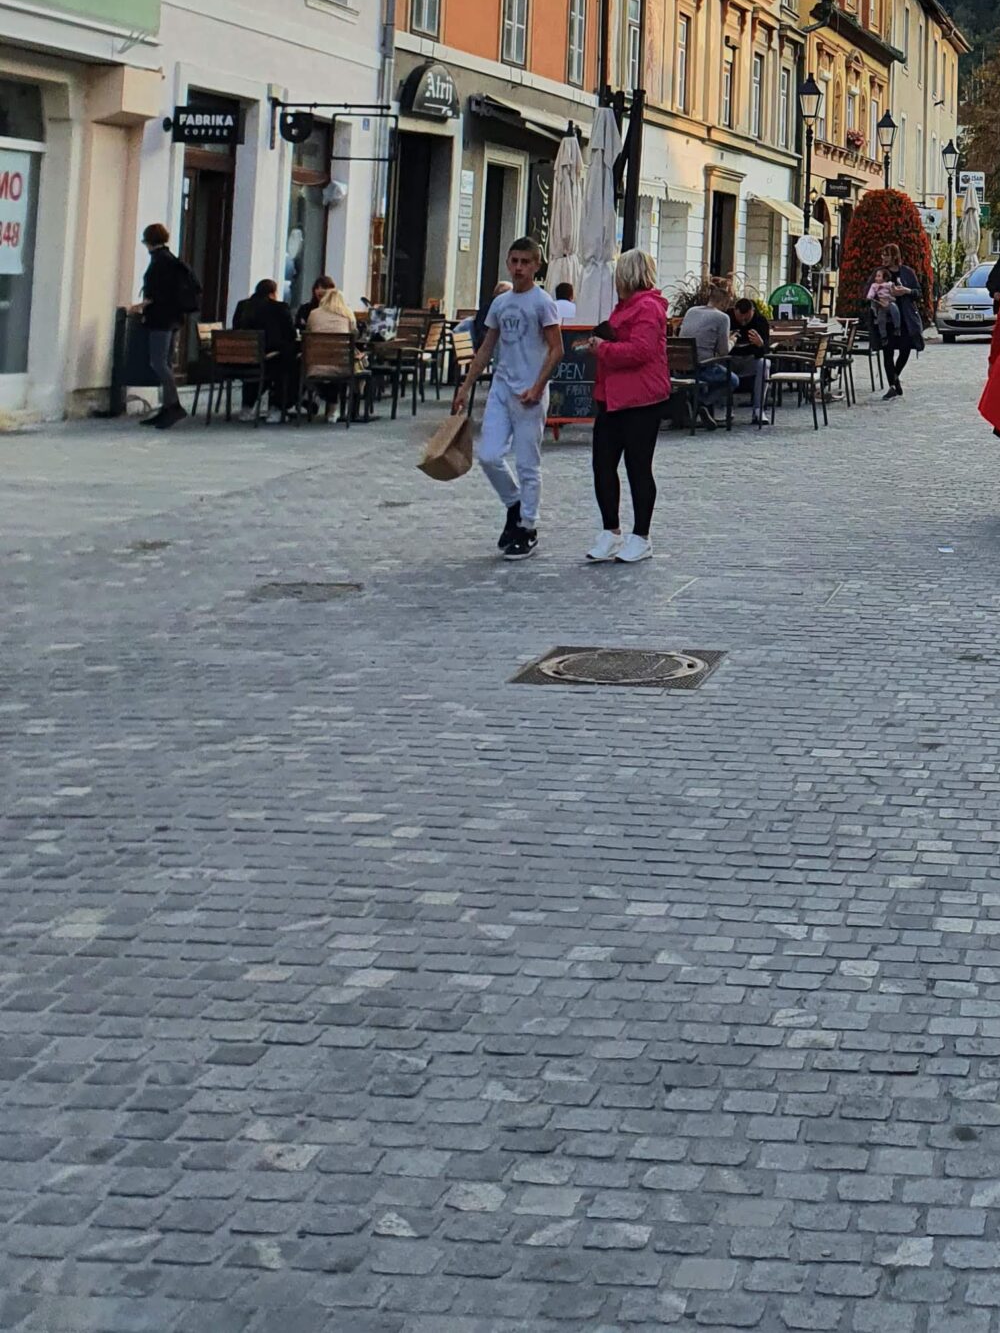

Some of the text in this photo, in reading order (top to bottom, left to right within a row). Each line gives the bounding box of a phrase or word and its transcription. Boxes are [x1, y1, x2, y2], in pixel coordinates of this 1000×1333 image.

[425, 72, 454, 105] Atrij
[179, 114, 234, 127] FABRIKA
[184, 128, 228, 137] COFFEE
[0, 221, 21, 248] 48
